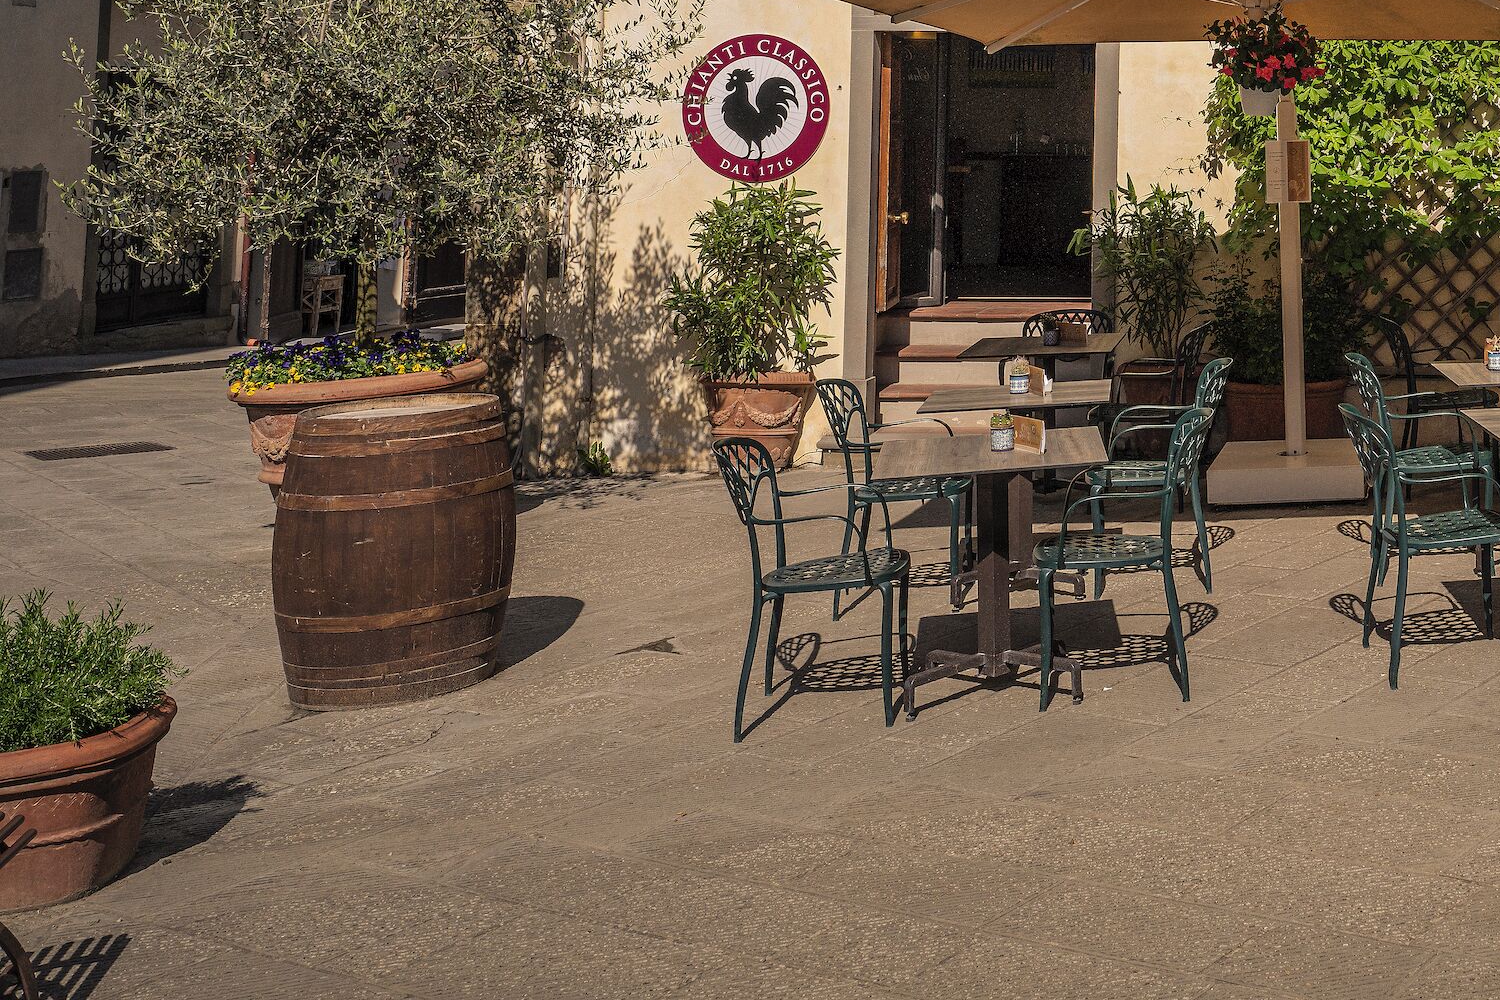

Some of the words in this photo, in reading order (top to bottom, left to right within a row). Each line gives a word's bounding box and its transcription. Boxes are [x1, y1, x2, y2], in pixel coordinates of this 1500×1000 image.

[687, 41, 747, 126] CHIANTI
[757, 39, 825, 123] CLASSICO
[720, 158, 750, 176] DAL
[758, 157, 793, 177] 1716
